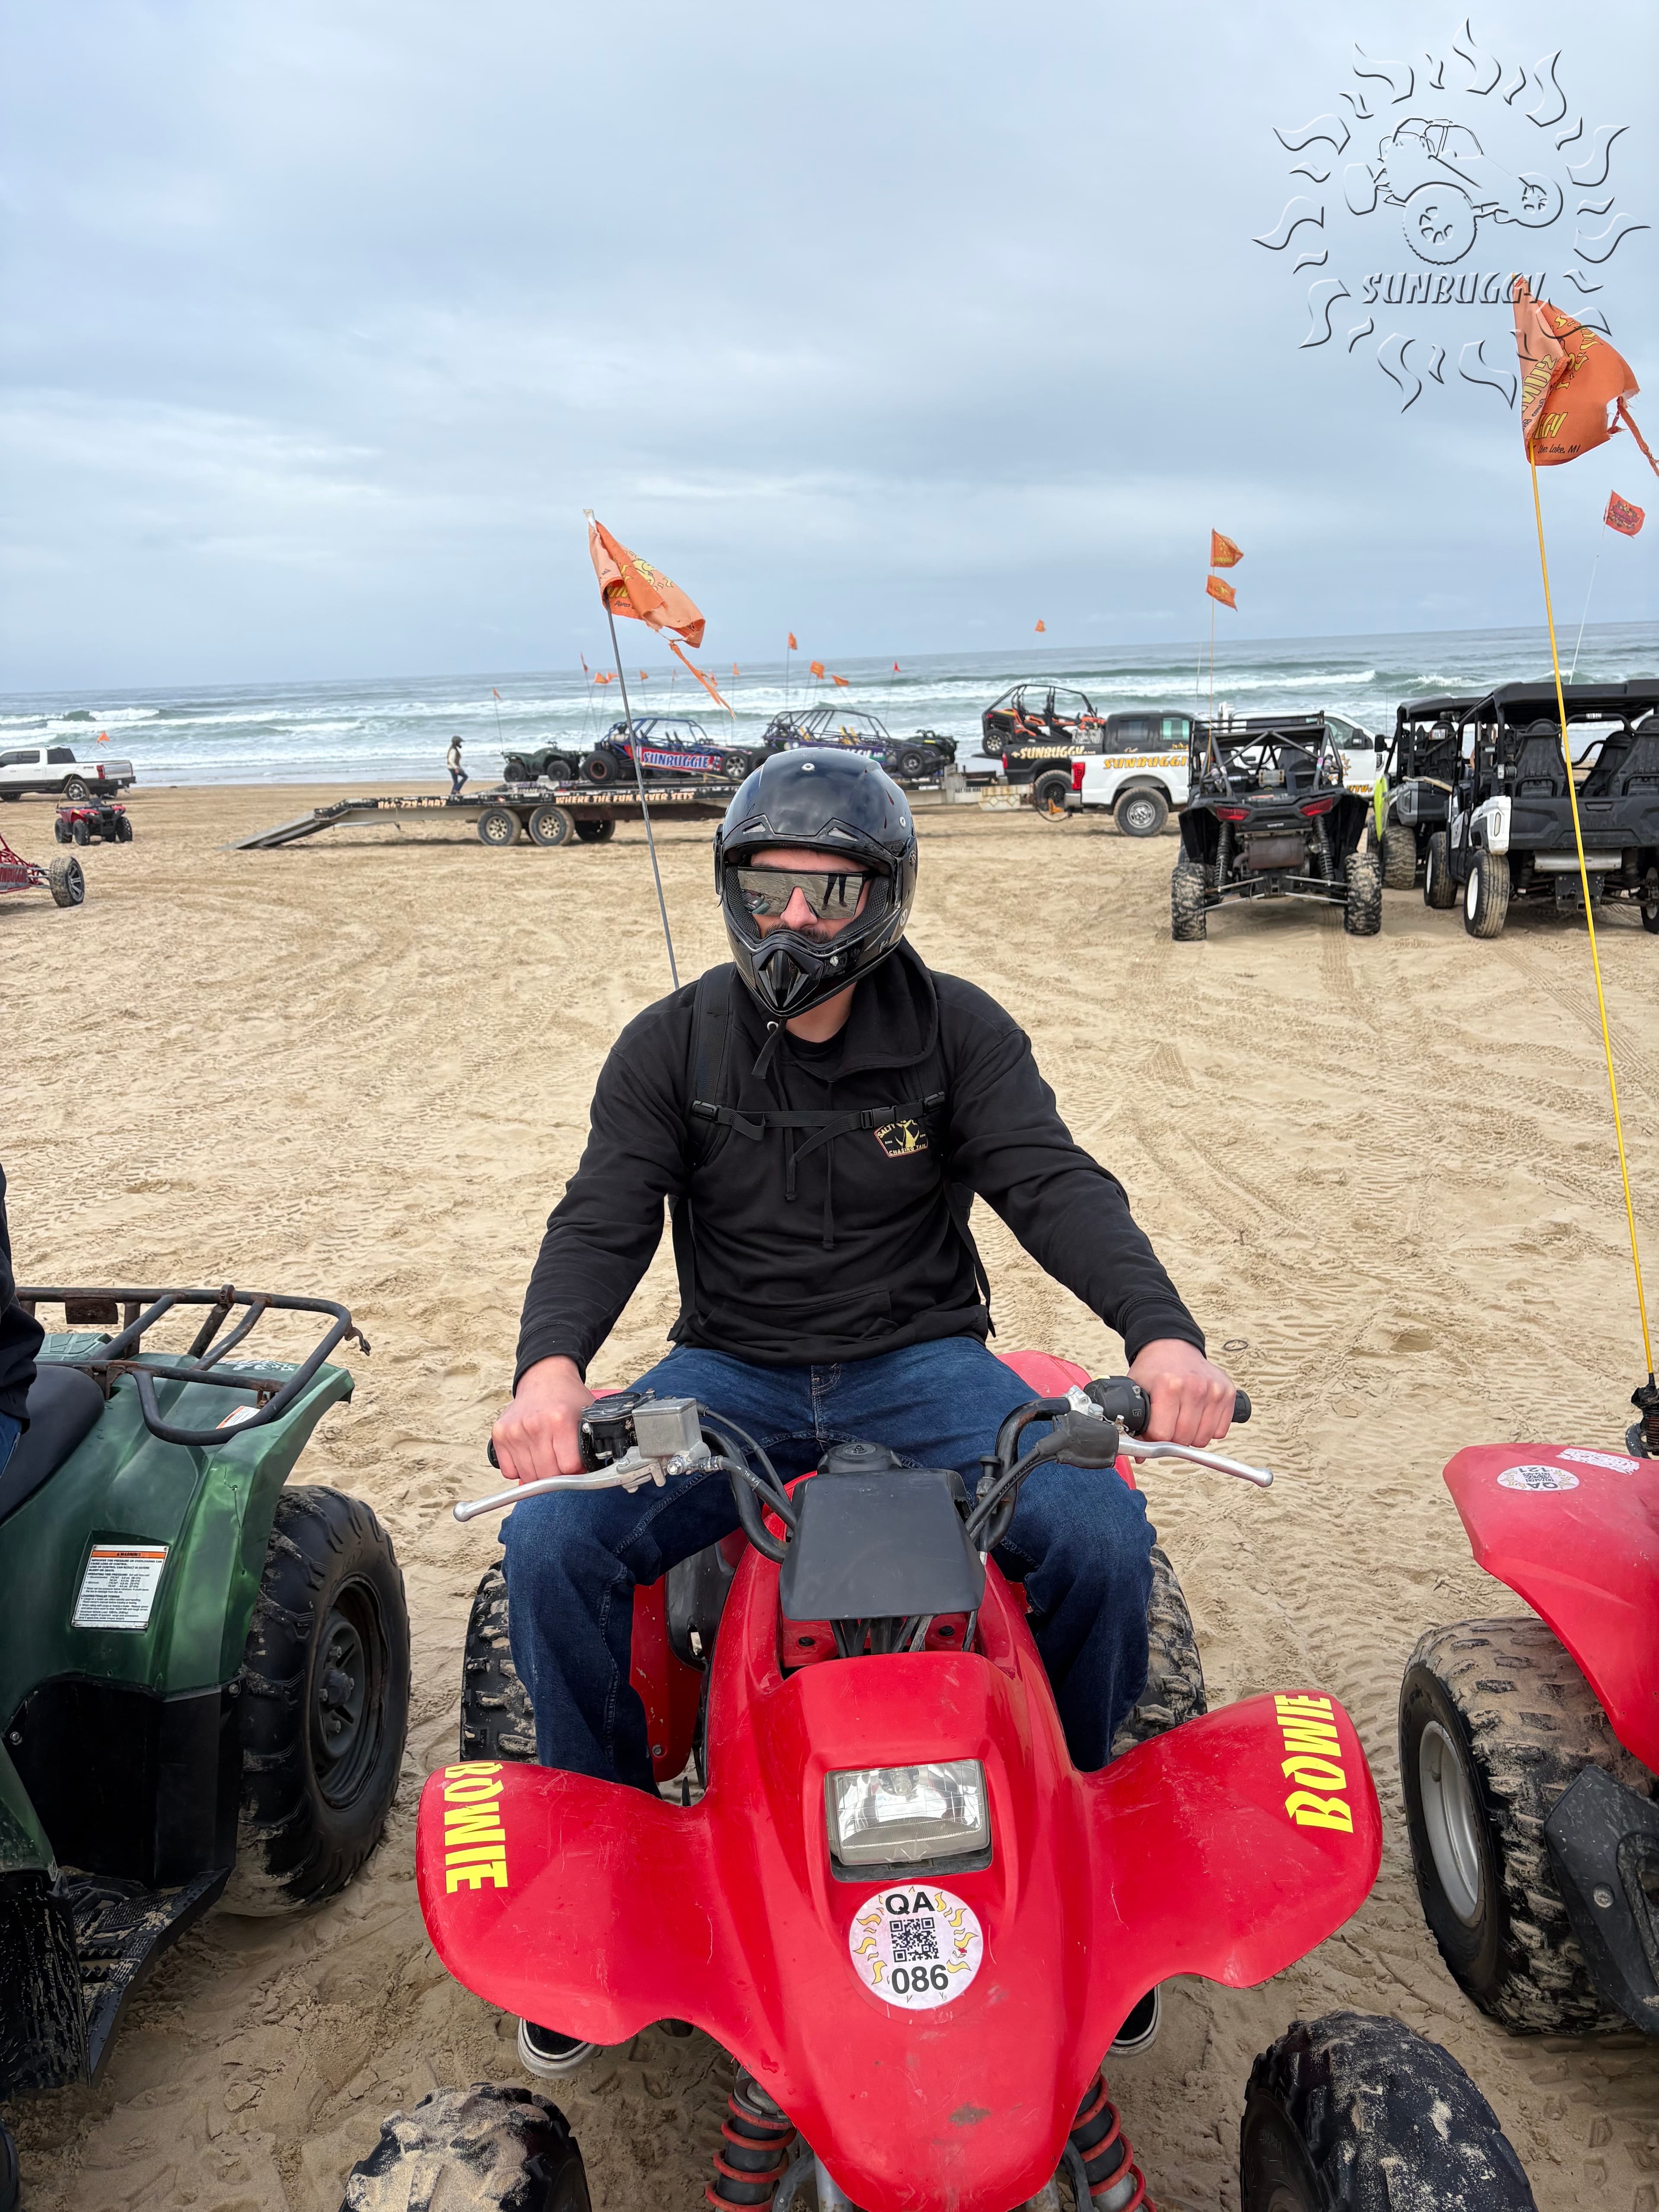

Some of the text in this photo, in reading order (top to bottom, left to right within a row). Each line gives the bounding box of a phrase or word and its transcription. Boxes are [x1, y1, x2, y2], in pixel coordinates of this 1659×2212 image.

[1568, 445, 1581, 453] MI
[643, 751, 709, 768] SUNBUGGIE
[556, 795, 590, 804] WHERE
[613, 794, 633, 802] FUN
[671, 792, 694, 800] SETS
[877, 1123, 896, 1138] SALTY
[889, 1147, 914, 1155] CHASING
[1274, 1695, 1354, 1833] BOWIE
[444, 1762, 508, 1894] BOWIE
[885, 1891, 935, 1915] QA
[891, 1964, 949, 1994] 086
